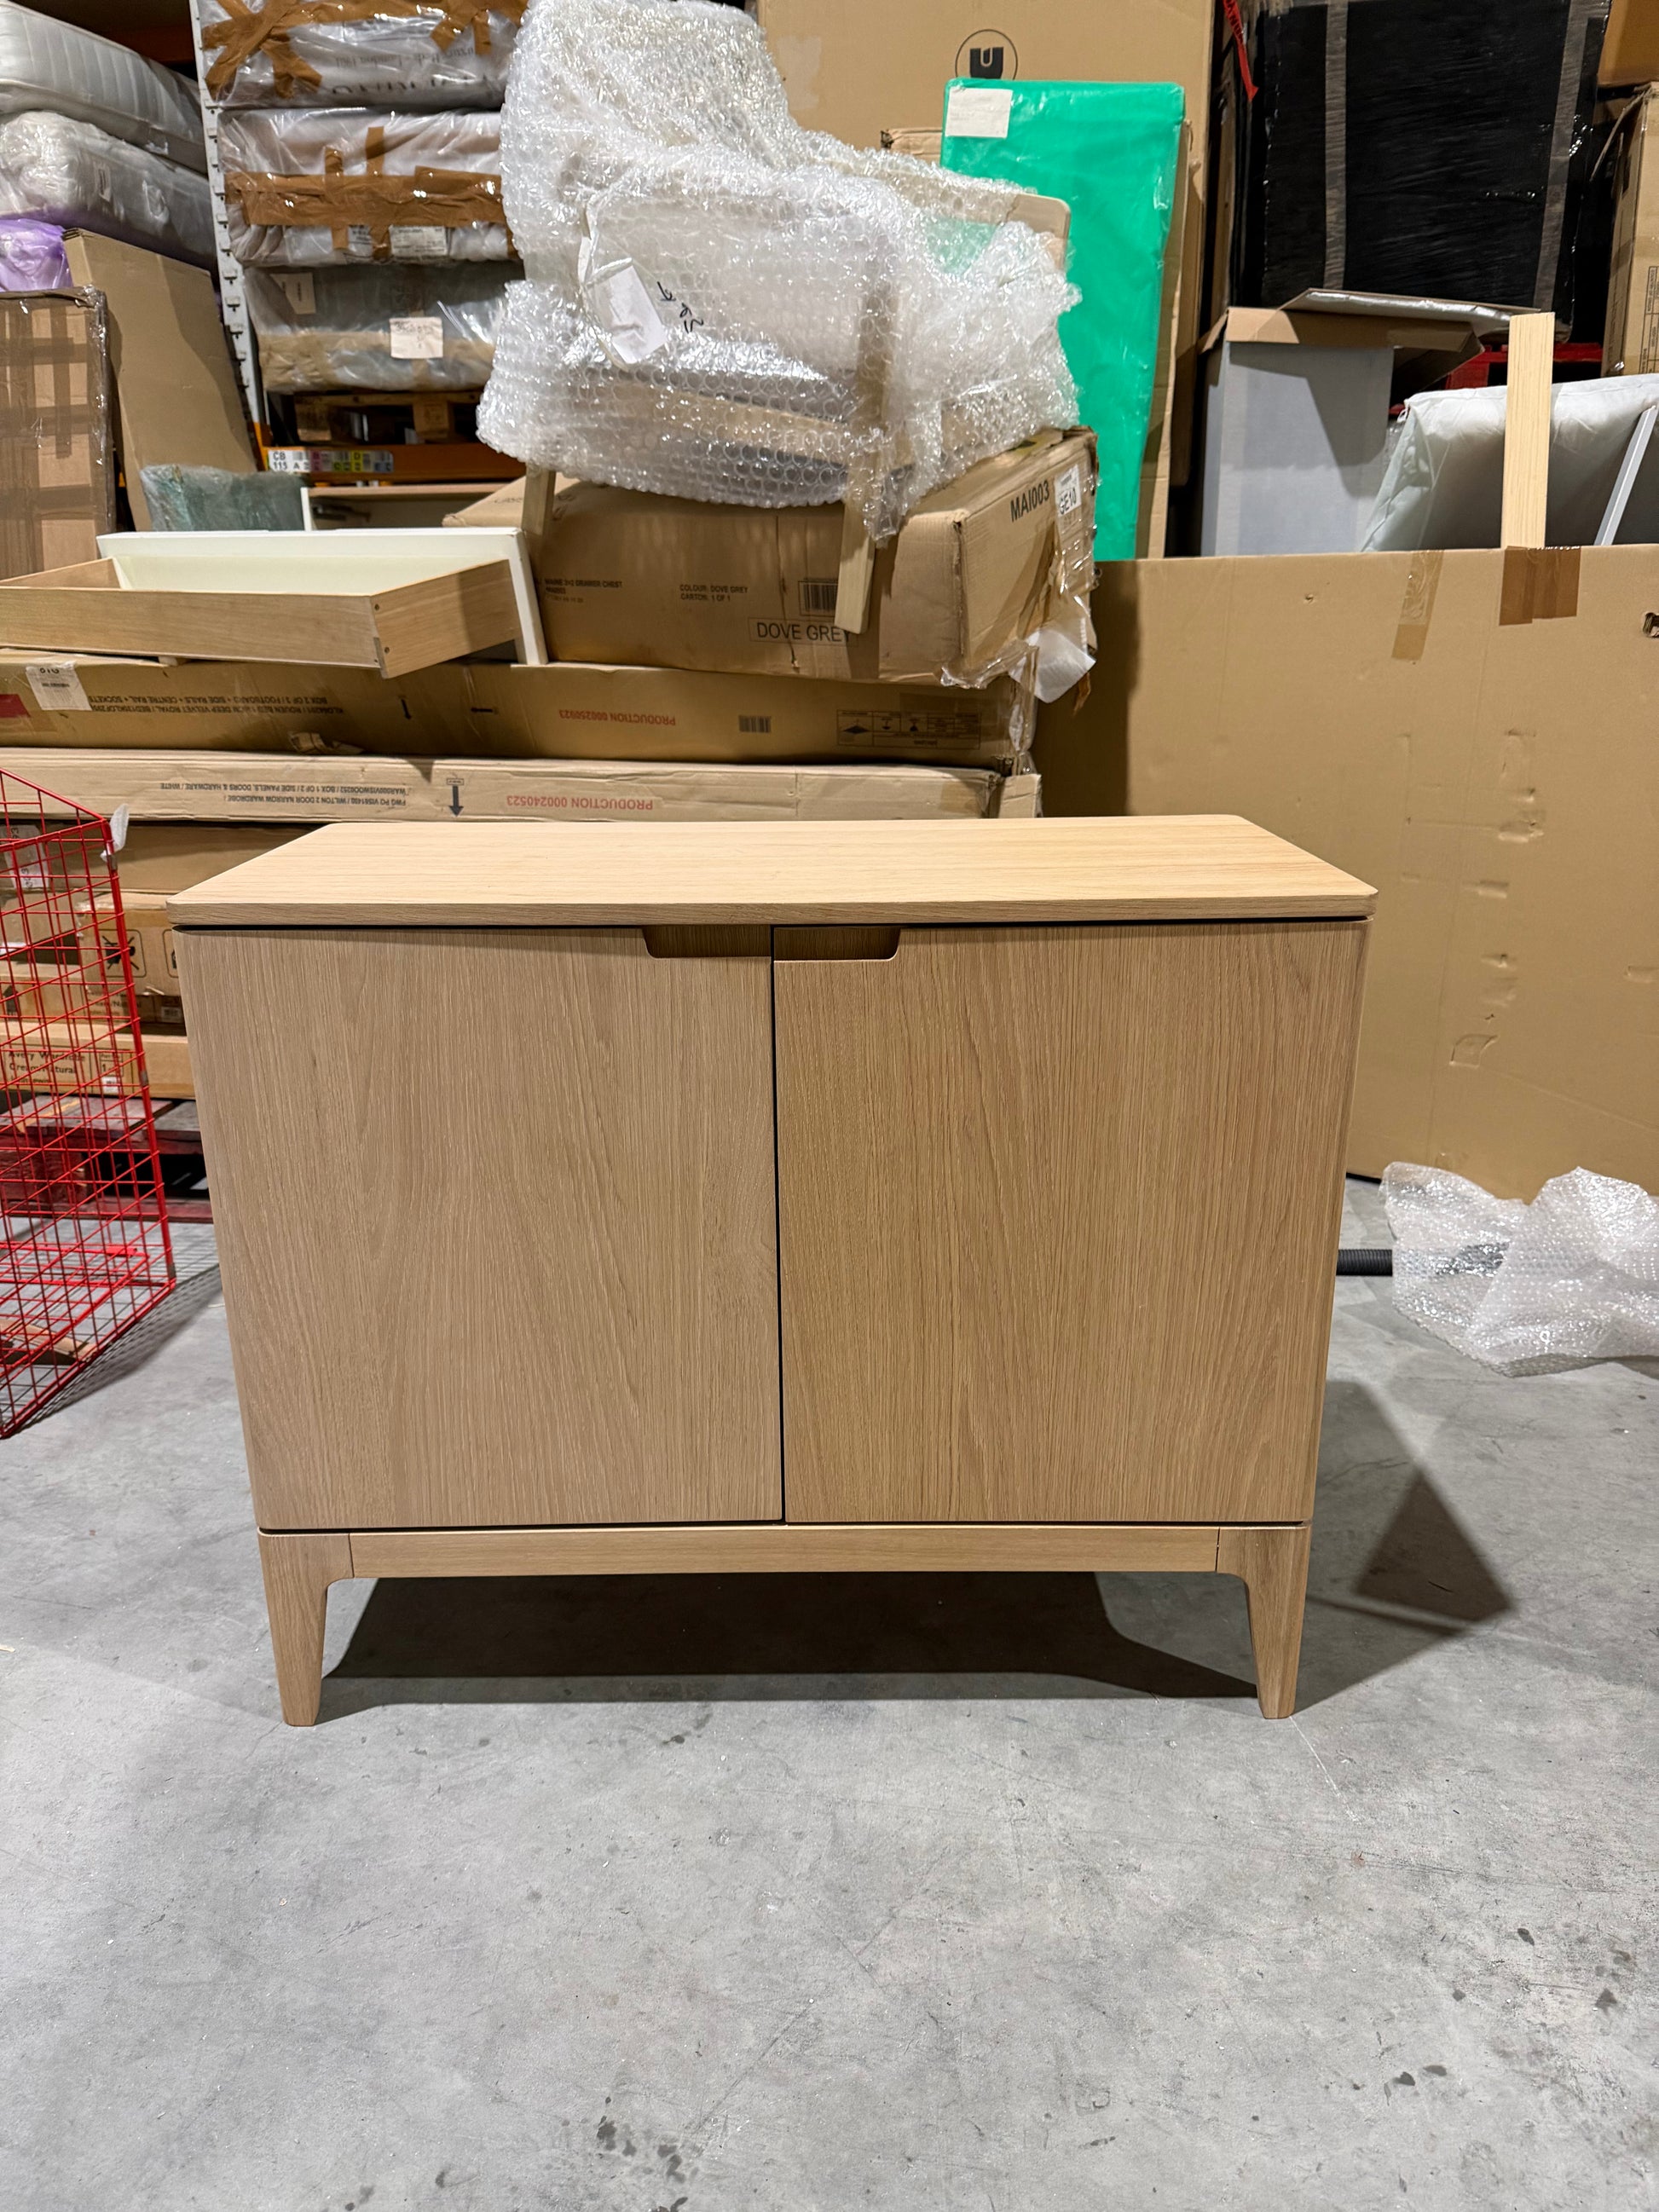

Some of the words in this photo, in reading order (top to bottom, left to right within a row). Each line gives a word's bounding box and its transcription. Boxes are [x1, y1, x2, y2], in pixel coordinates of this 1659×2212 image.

[1010, 480, 1049, 523] MAI003
[710, 585, 728, 593] DOVE
[757, 622, 801, 640] DOVE
[610, 713, 676, 725] PRODUCTION
[506, 795, 568, 807] 000240523
[571, 797, 653, 811] PRODUCTION
